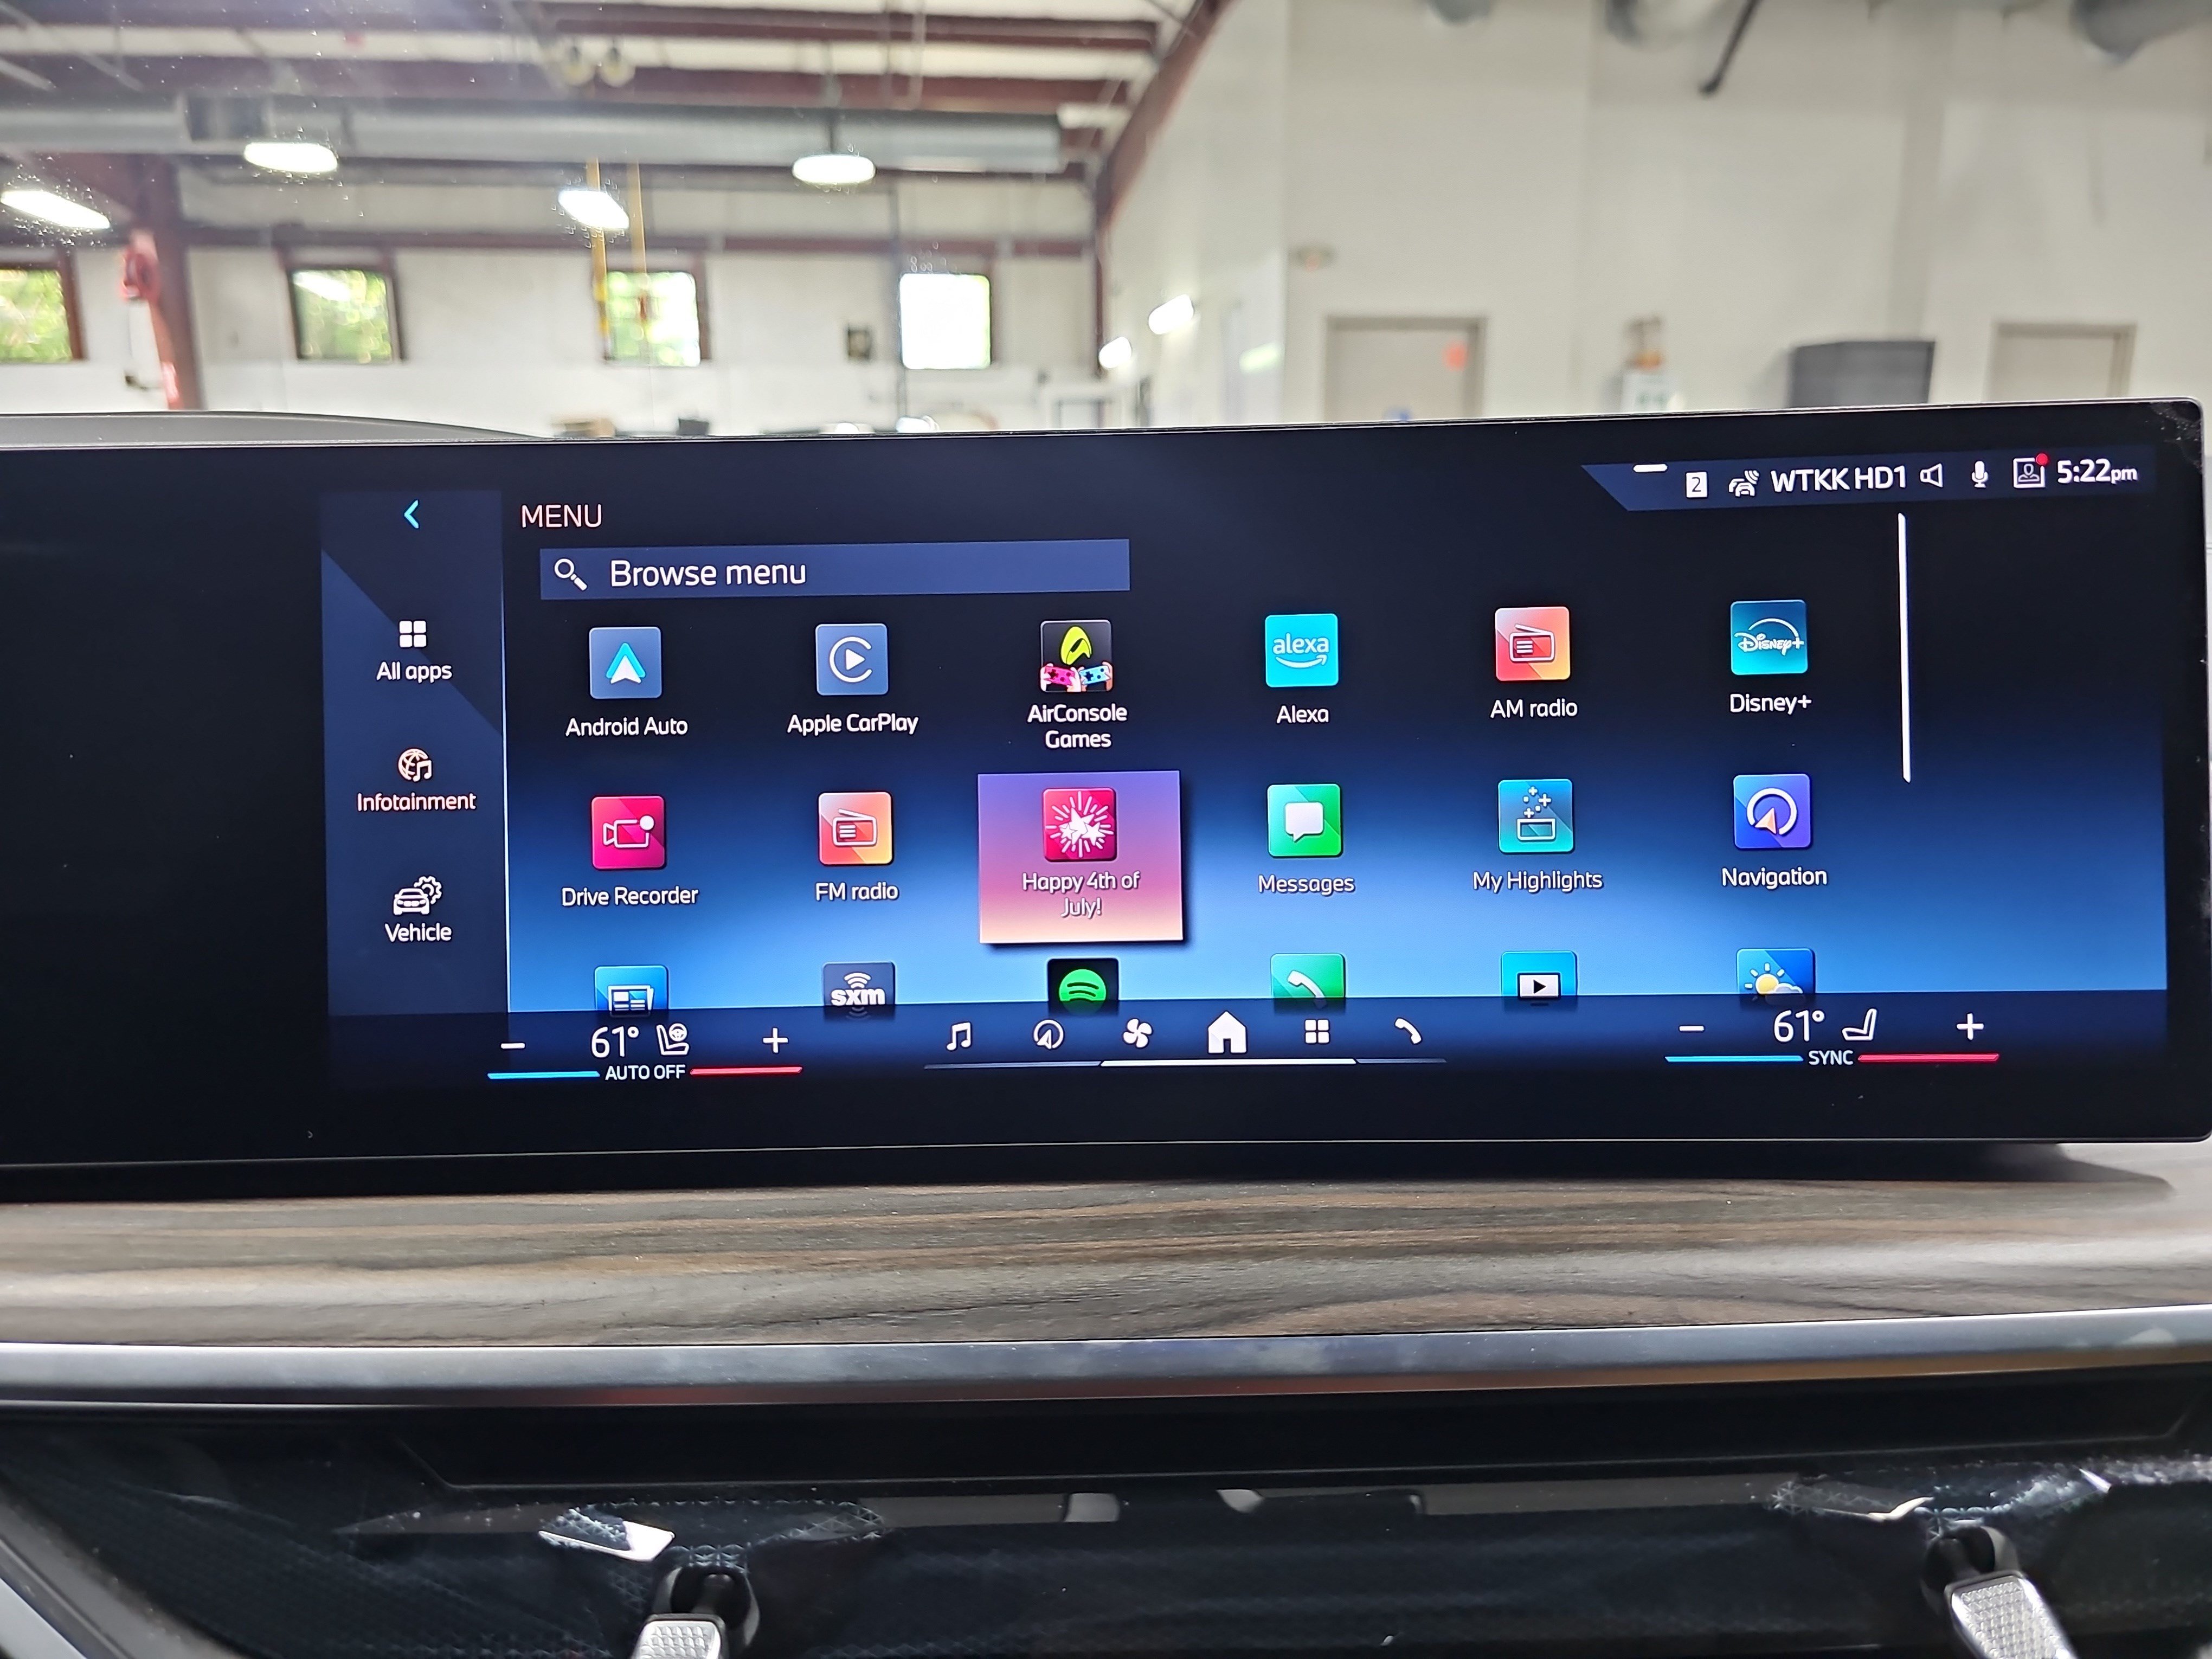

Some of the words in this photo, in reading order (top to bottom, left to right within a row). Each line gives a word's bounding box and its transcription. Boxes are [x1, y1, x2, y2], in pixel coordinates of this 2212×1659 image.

[1771, 467, 1850, 492] WTKK
[1855, 465, 1906, 490] HD1
[2057, 458, 2137, 484] 5:22pm
[522, 504, 602, 528] MENU
[611, 560, 717, 587] Browse
[726, 564, 806, 584] menu
[1272, 633, 1329, 654] alexa
[376, 661, 401, 680] All
[406, 665, 452, 683] apps
[1027, 703, 1128, 723] AirConsole
[1276, 705, 1329, 724] Alexa
[1490, 699, 1523, 718] AM
[1530, 698, 1578, 717] radio
[1730, 693, 1812, 715] Disney+
[565, 717, 639, 737] Android
[644, 716, 688, 735] Auto
[787, 714, 842, 736] Apple
[846, 713, 919, 735] CarPlay
[1045, 730, 1111, 748] Games
[357, 792, 477, 812] Infotainment
[1023, 872, 1084, 893] Happy
[1086, 871, 1116, 889] 4th
[1121, 871, 1140, 889] of
[1259, 874, 1354, 895] Messages
[1474, 871, 1502, 893] My
[1508, 870, 1602, 892] Highlights
[1722, 866, 1827, 889] Navigation
[562, 888, 609, 906] Drive
[615, 886, 699, 905] Recorder
[816, 883, 846, 901] FM
[852, 882, 898, 900] radio
[1061, 898, 1102, 919] July!
[384, 922, 452, 942] Vehicle
[831, 988, 886, 1006] sxm
[1774, 1010, 1824, 1042] 61°
[591, 1026, 639, 1058] 61°
[1809, 1050, 1854, 1065] SYNC
[605, 1065, 650, 1081] AUTO
[654, 1064, 686, 1079] OFF
